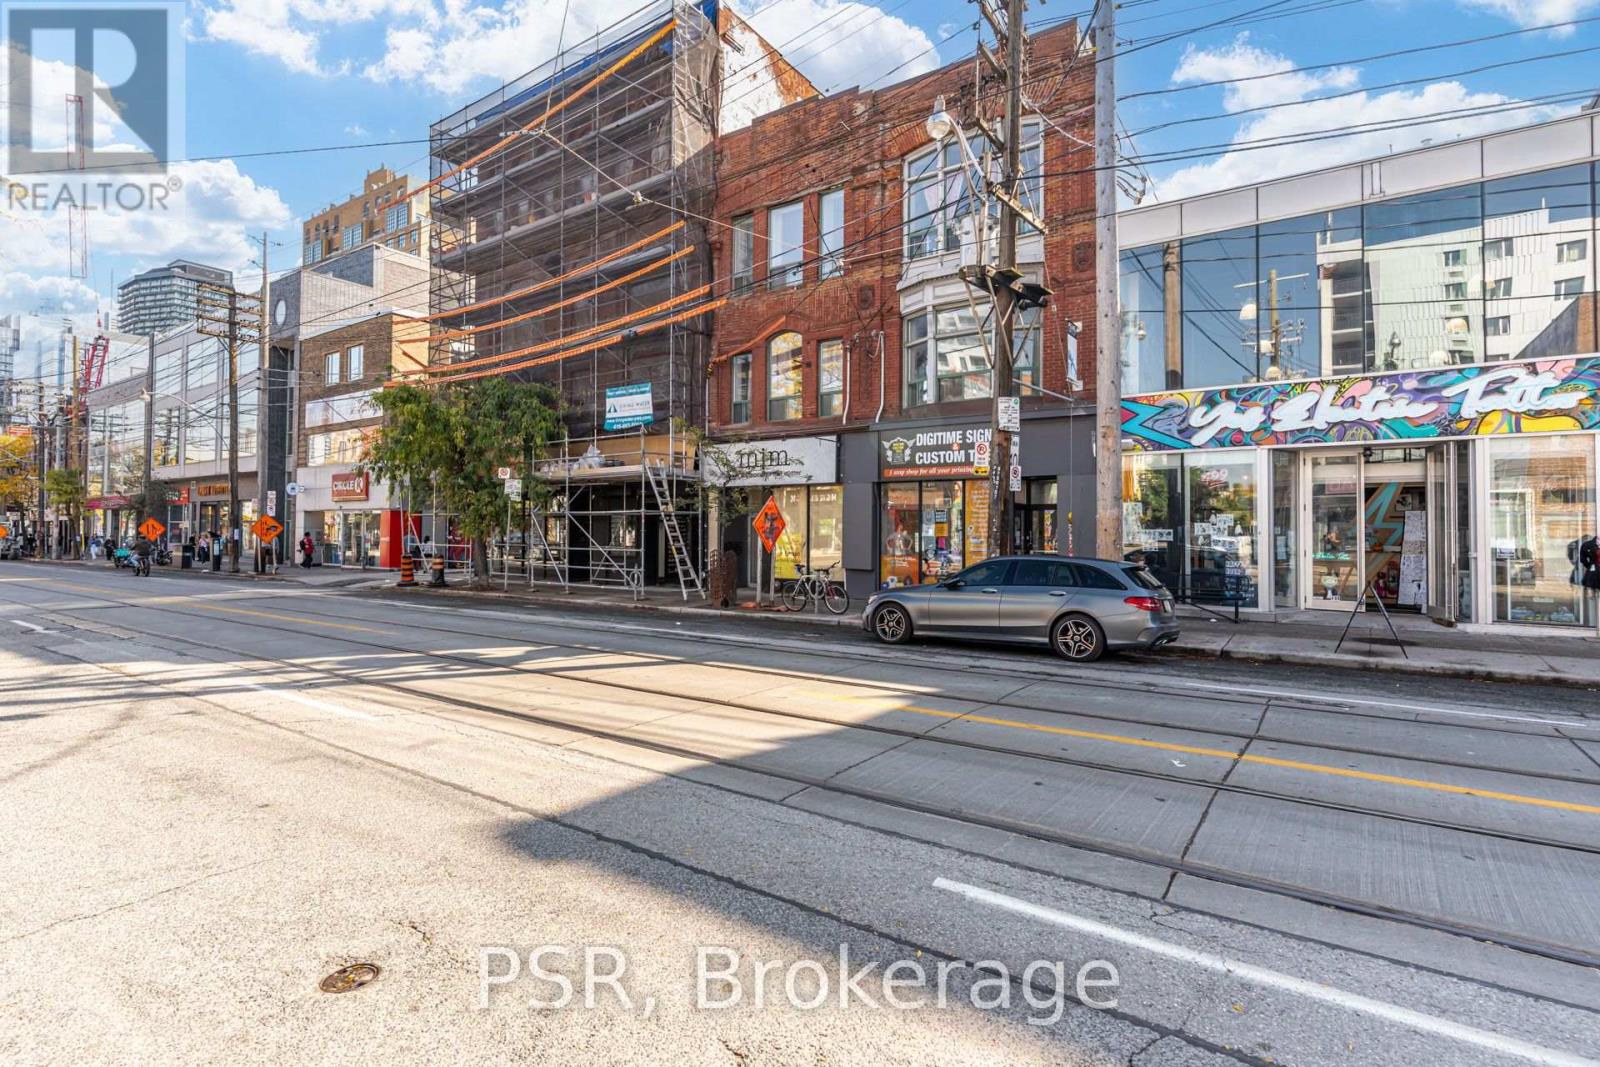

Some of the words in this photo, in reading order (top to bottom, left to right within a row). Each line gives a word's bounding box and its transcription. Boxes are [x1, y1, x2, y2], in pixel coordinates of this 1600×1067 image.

[916, 430, 963, 446] DIGITIME
[966, 428, 992, 443] SIGN
[915, 450, 965, 465] CUSTOM
[906, 468, 919, 476] shop
[920, 467, 929, 476] for
